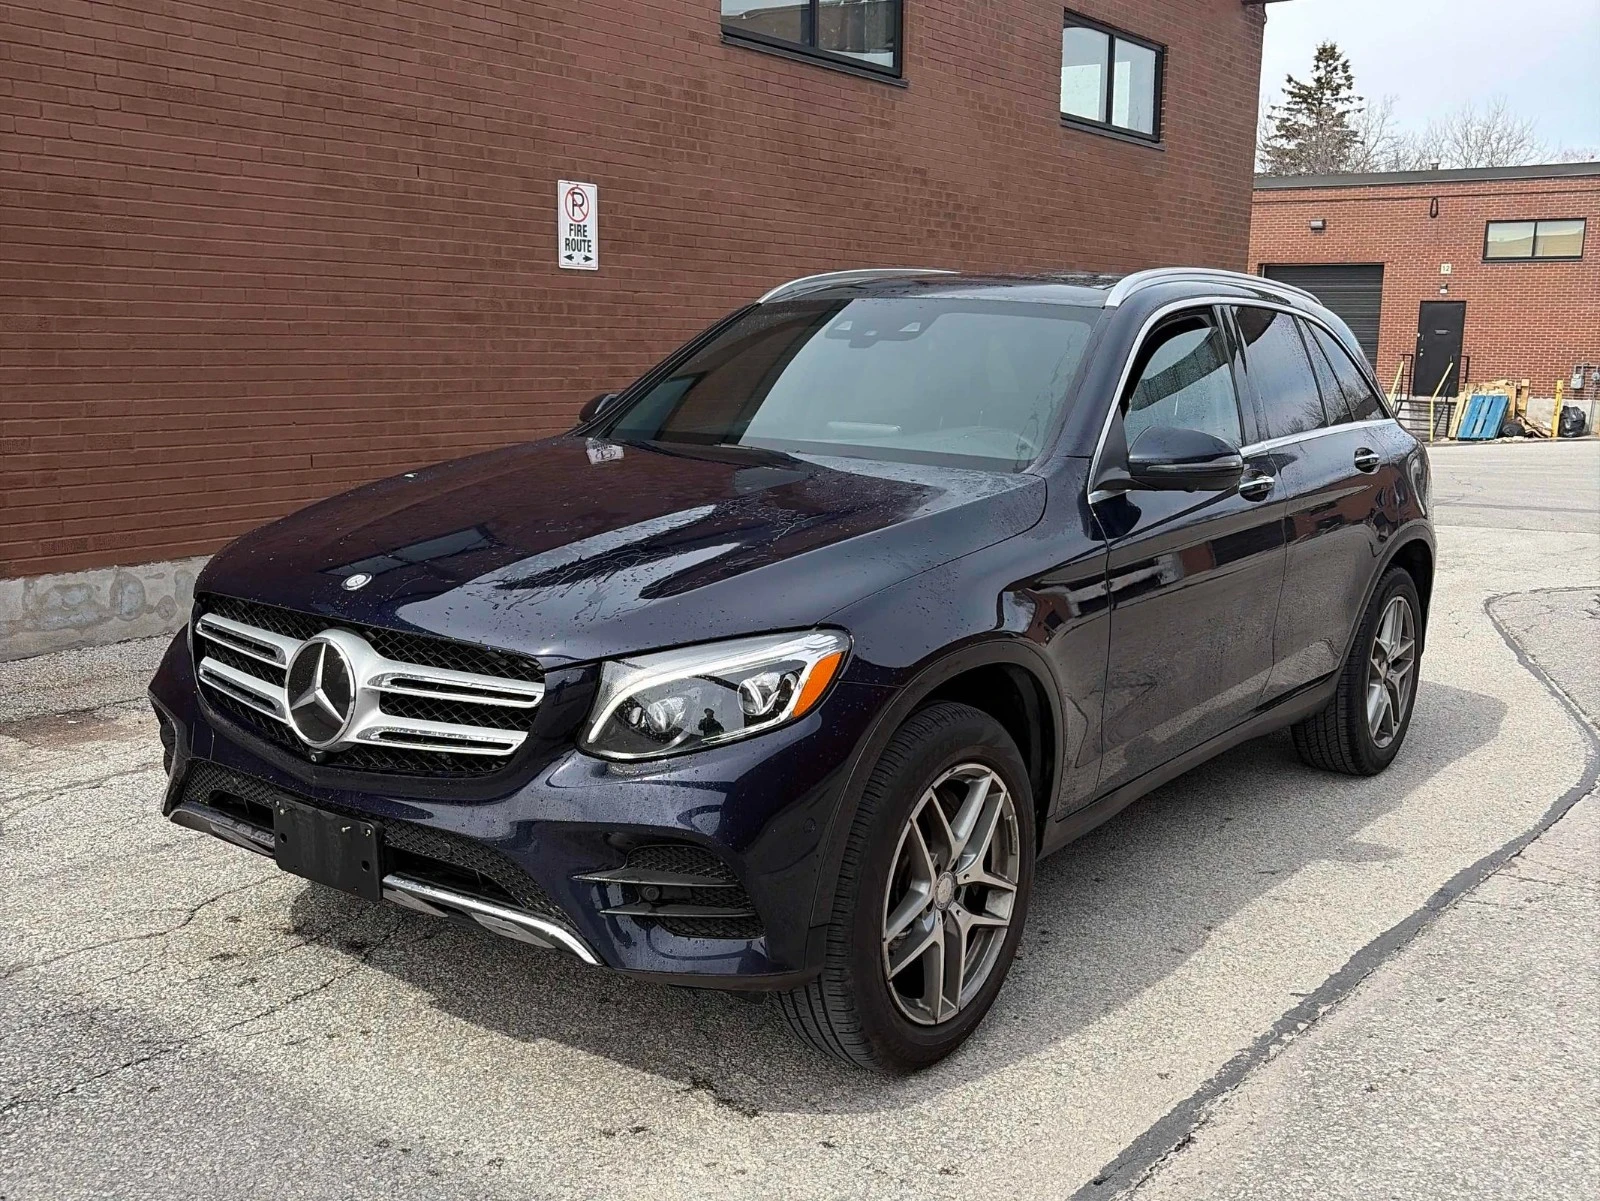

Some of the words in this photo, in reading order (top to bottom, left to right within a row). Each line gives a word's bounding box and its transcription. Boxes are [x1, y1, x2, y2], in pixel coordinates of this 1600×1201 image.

[572, 191, 585, 217] P
[569, 223, 588, 238] FIRE
[565, 237, 592, 253] ROUTE
